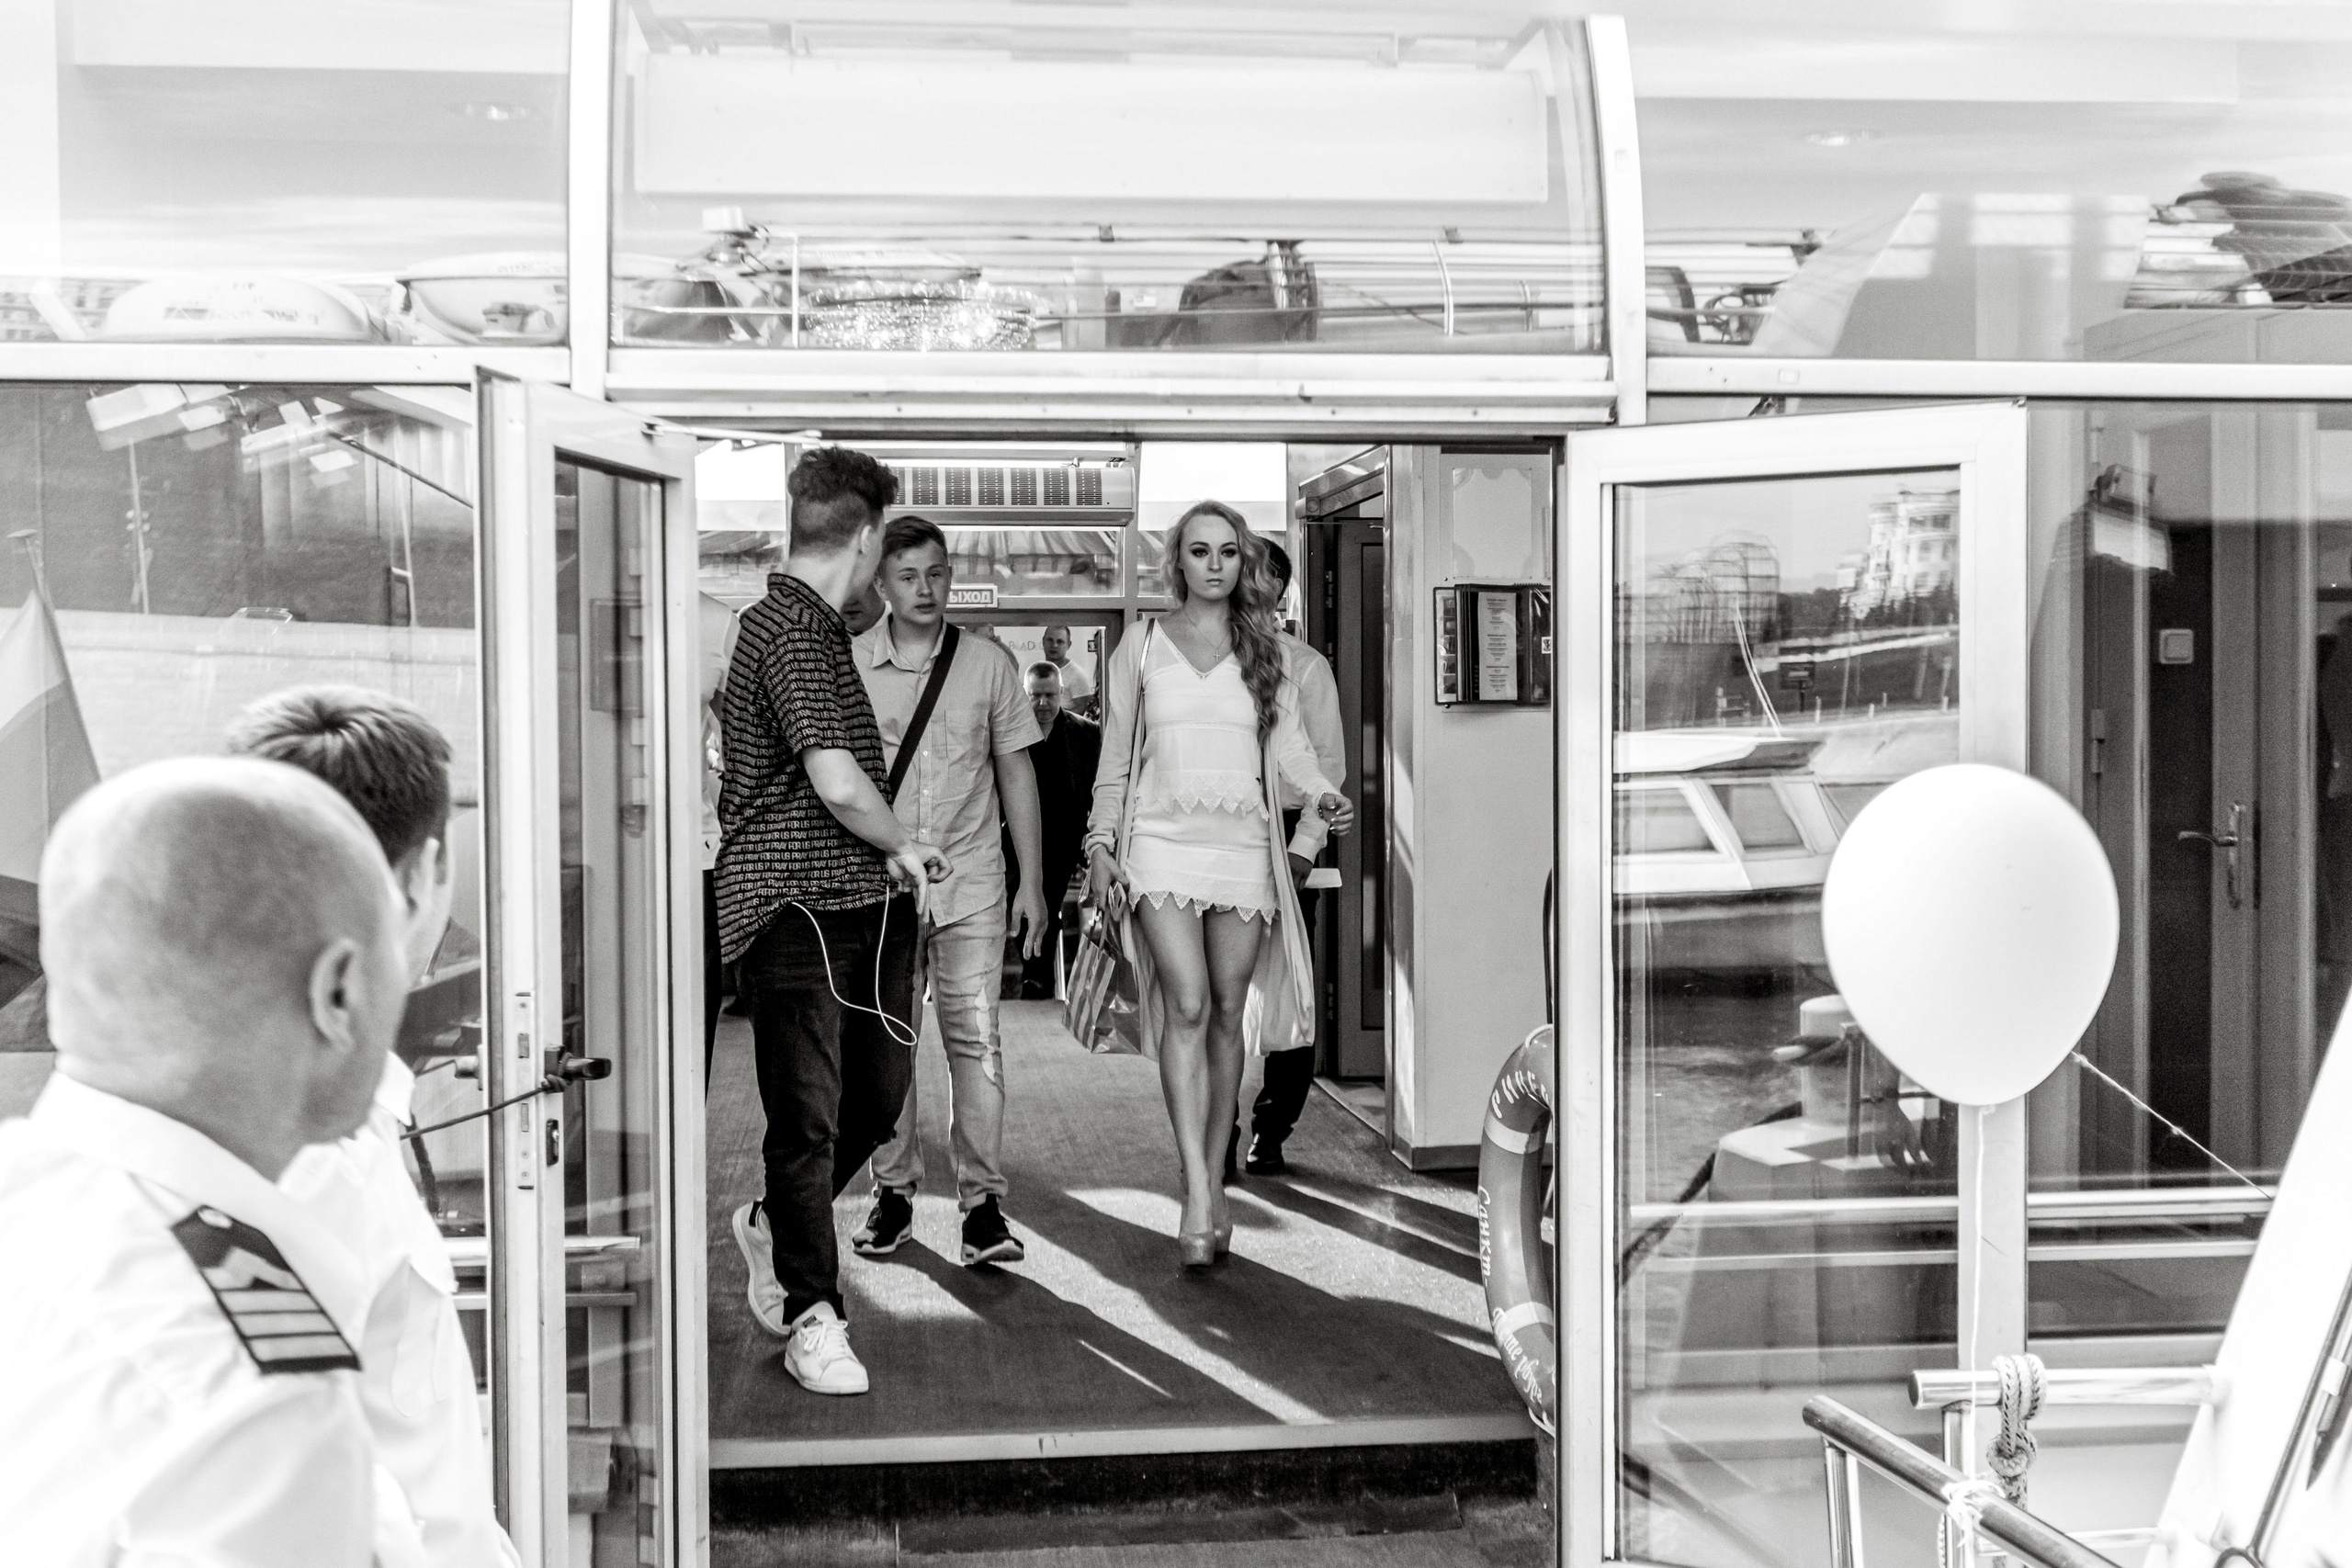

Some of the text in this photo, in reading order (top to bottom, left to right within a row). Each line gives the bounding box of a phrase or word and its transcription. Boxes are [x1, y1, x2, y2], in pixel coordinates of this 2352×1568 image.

[948, 591, 991, 604] ЫХОД
[792, 852, 808, 860] PRAY
[811, 860, 827, 868] PRAY
